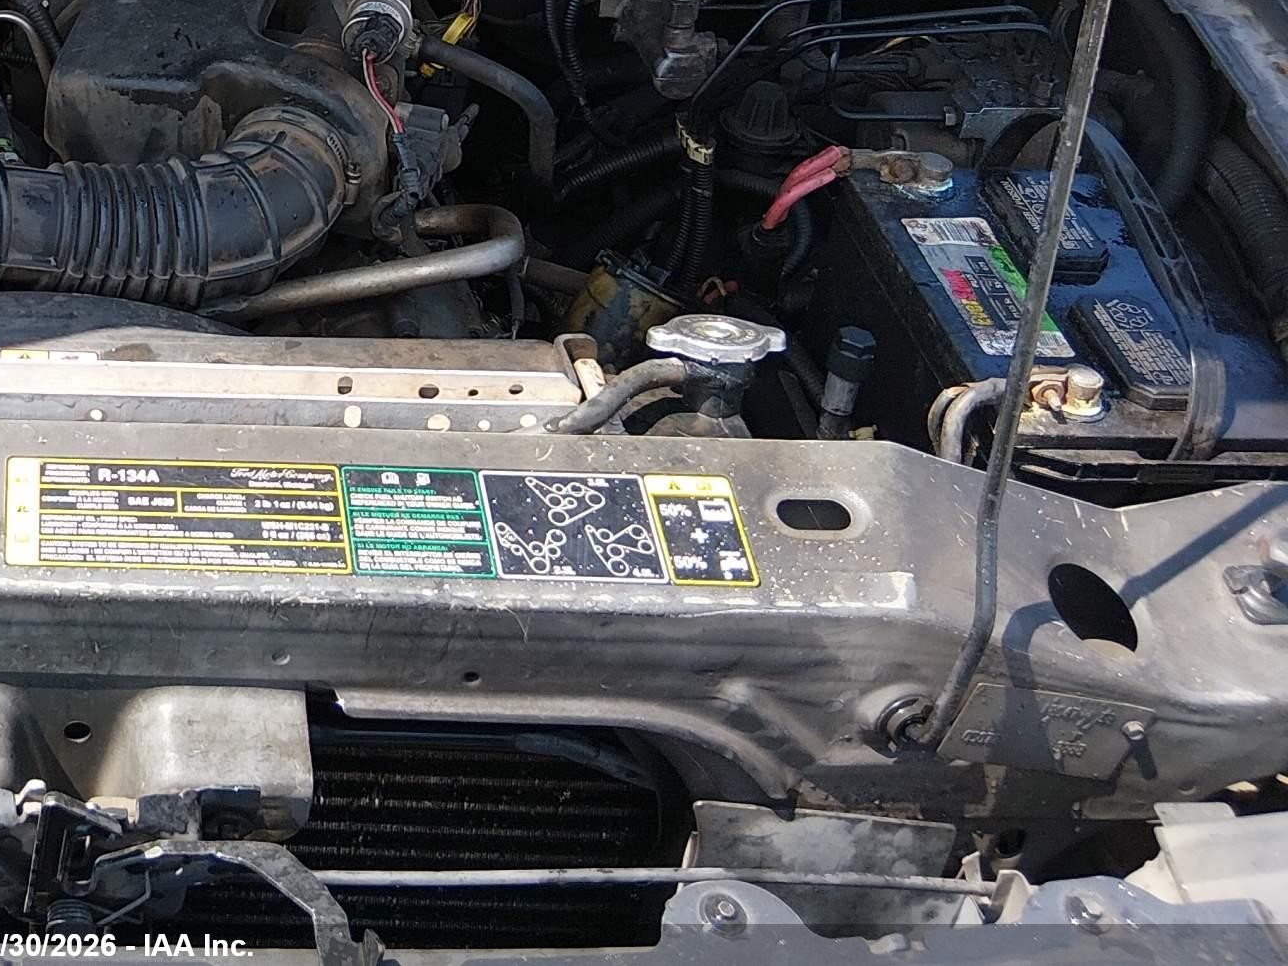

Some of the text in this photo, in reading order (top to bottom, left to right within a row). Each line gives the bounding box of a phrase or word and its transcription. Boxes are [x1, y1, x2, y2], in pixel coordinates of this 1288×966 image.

[97, 467, 161, 484] R-134A
[661, 503, 693, 518] 50%
[674, 555, 708, 570] 50%
